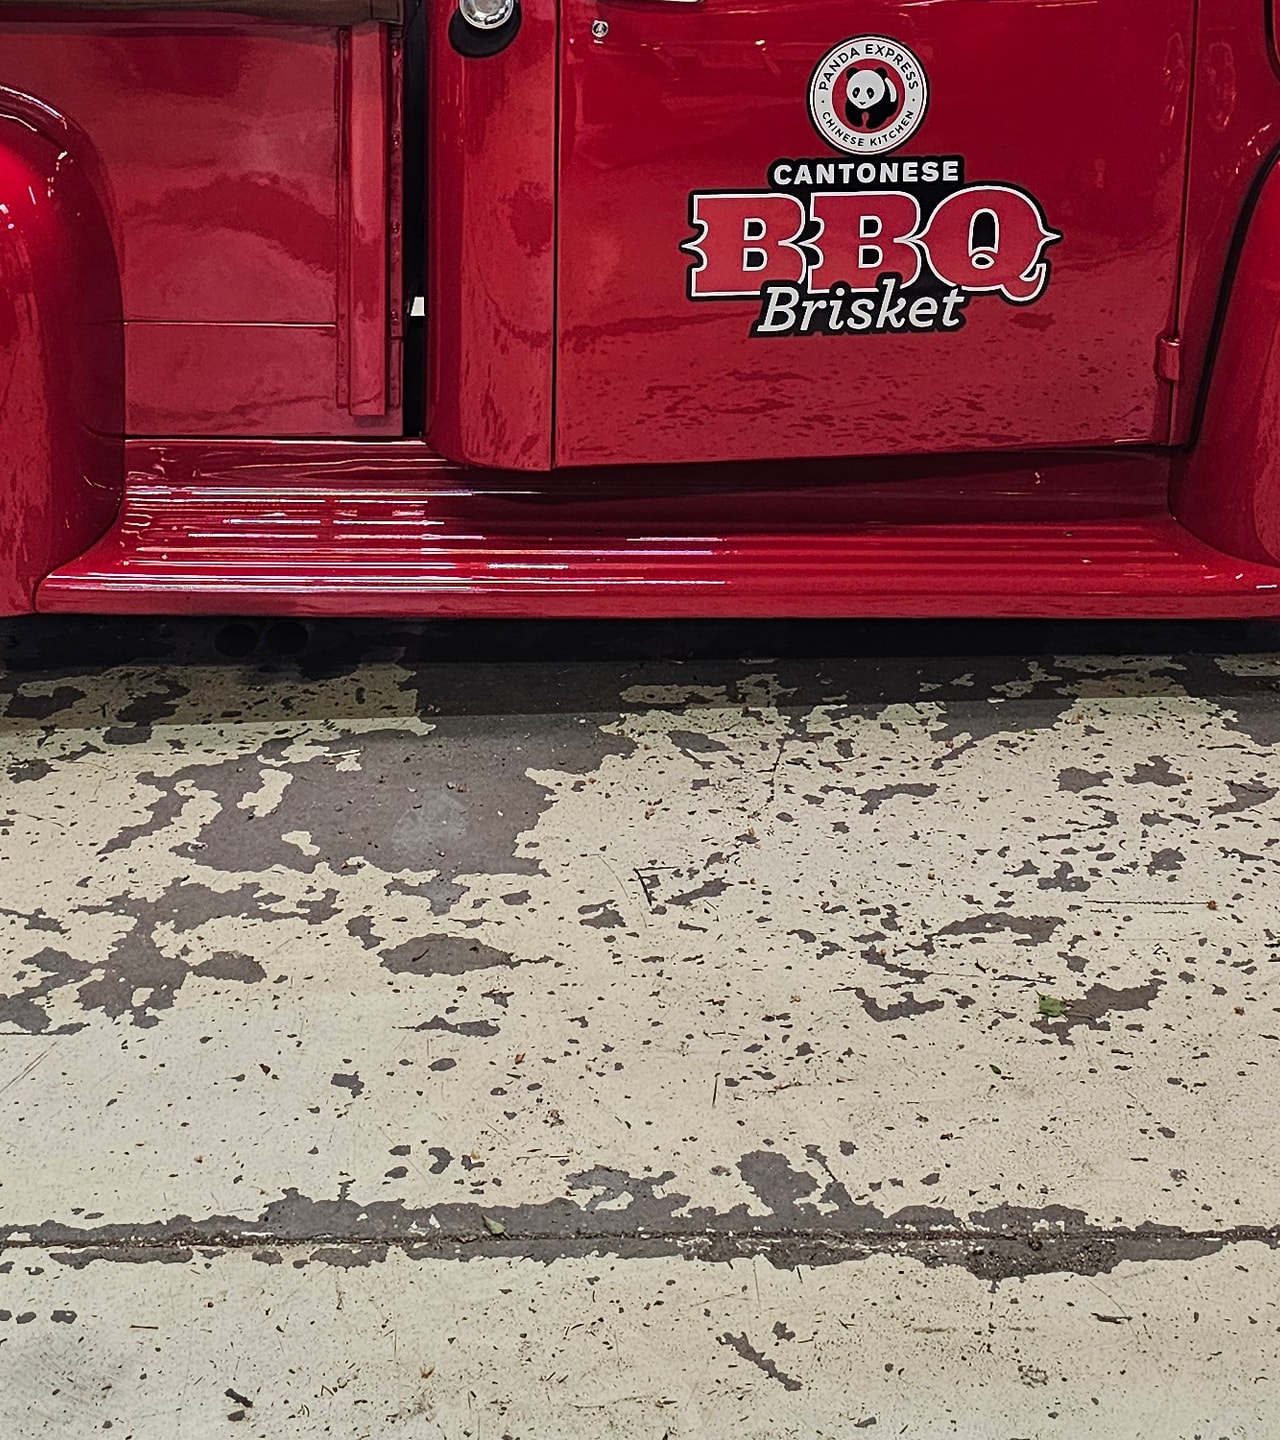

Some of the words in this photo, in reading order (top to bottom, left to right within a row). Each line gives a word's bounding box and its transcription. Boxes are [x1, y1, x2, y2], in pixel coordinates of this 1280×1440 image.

[818, 46, 861, 91] PANDA
[865, 43, 919, 90] EXPRESS
[822, 111, 865, 147] CHINESE
[869, 110, 915, 147] KITCHEN
[773, 160, 959, 186] CANTONESE
[680, 184, 1062, 303] BBQ
[756, 277, 965, 334] Brisket
